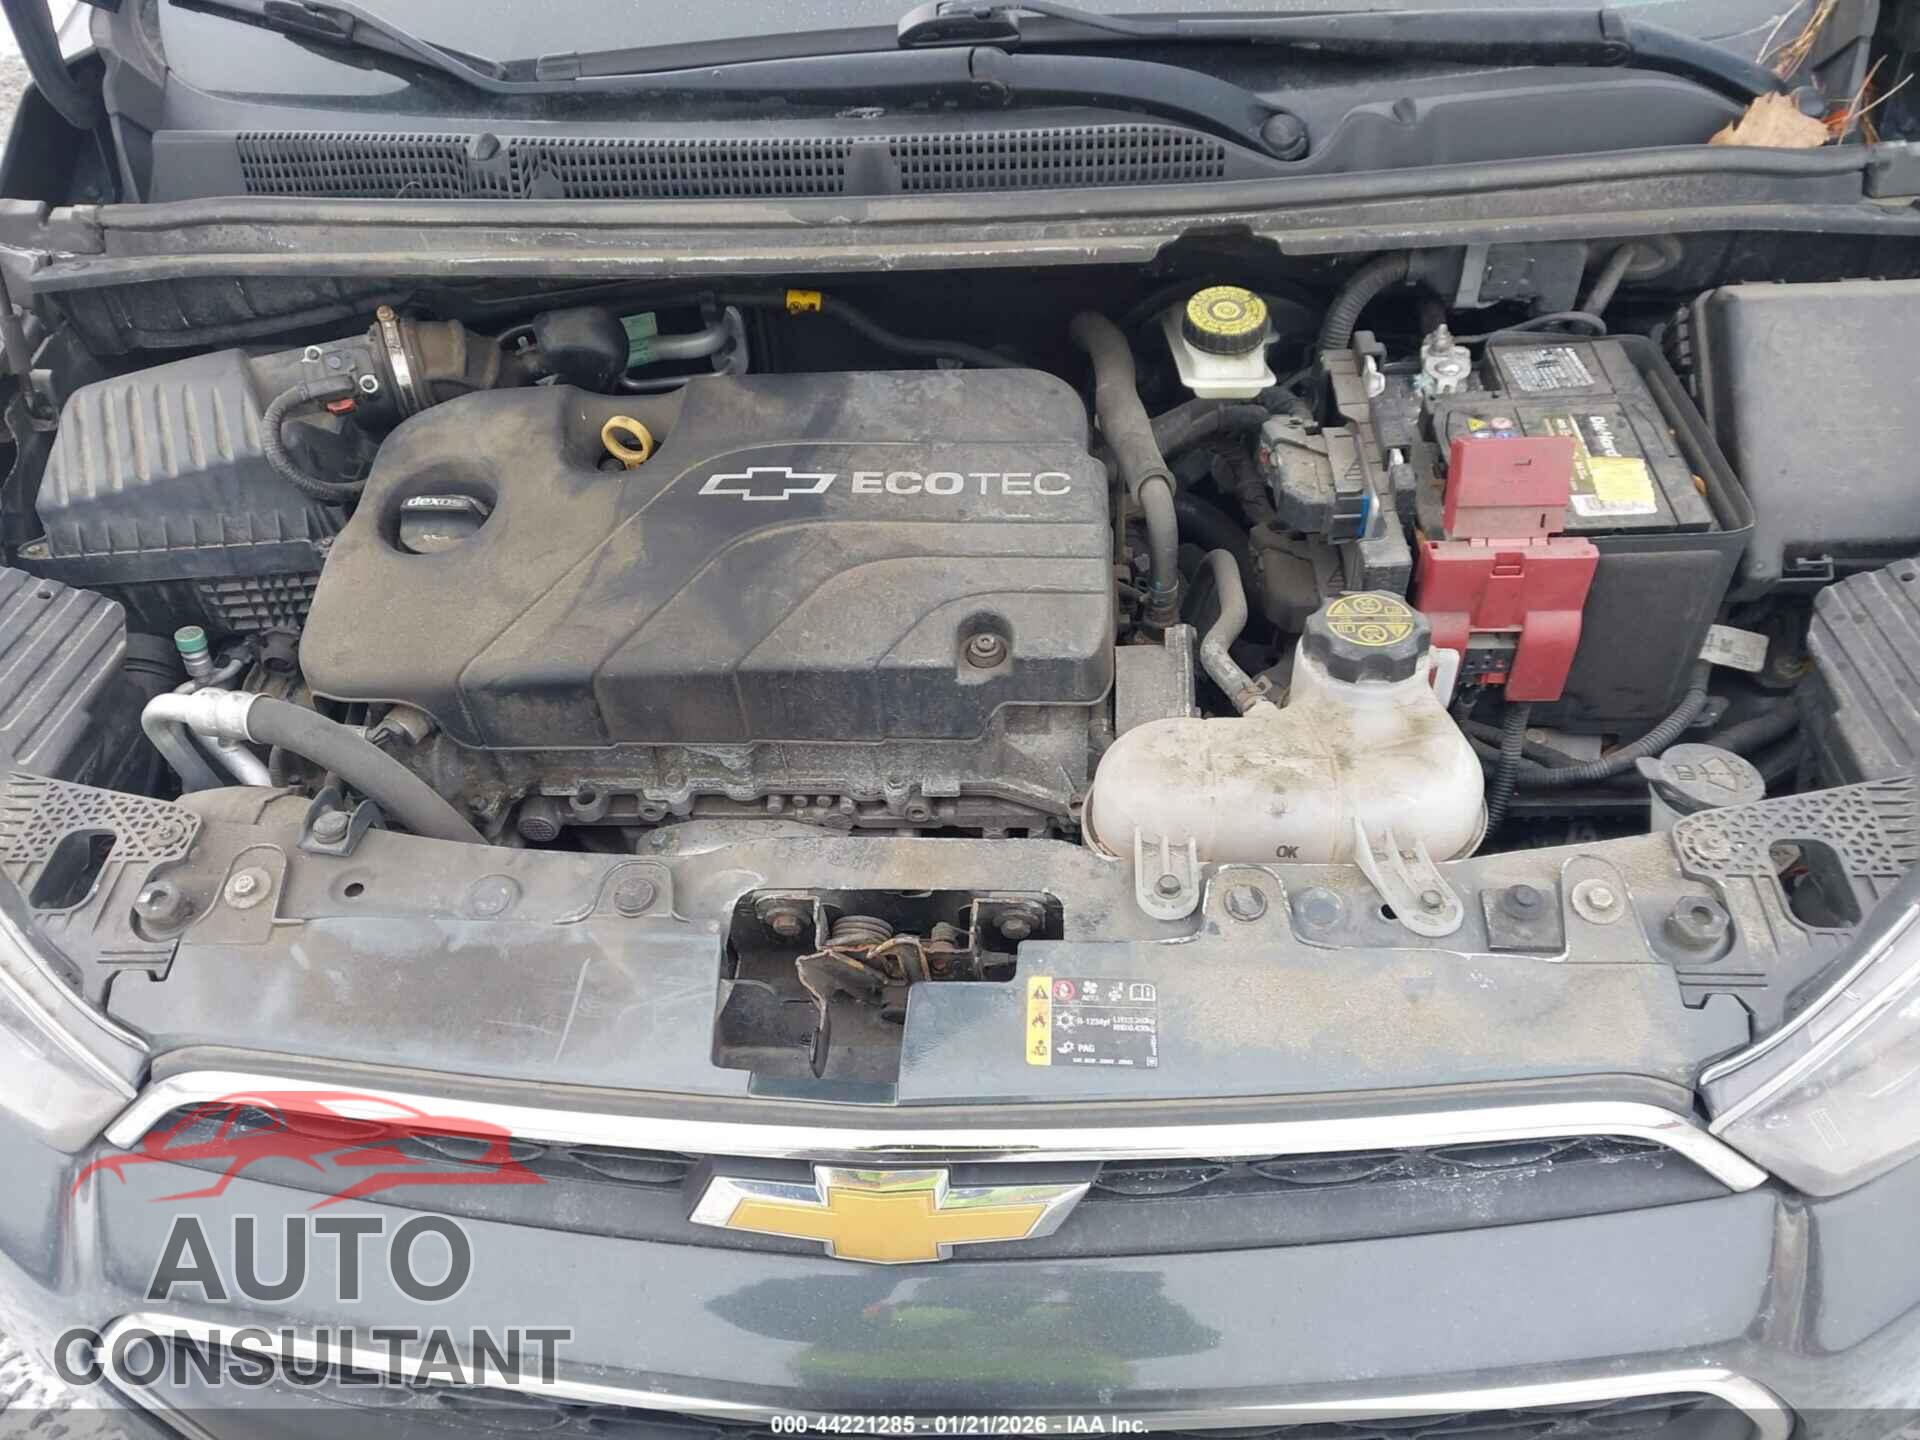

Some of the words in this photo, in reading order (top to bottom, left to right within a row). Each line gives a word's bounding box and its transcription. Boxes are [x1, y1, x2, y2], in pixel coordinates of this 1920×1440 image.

[851, 471, 1072, 496] ECOTEC
[1276, 845, 1301, 858] OK
[1077, 1043, 1096, 1053] PAG
